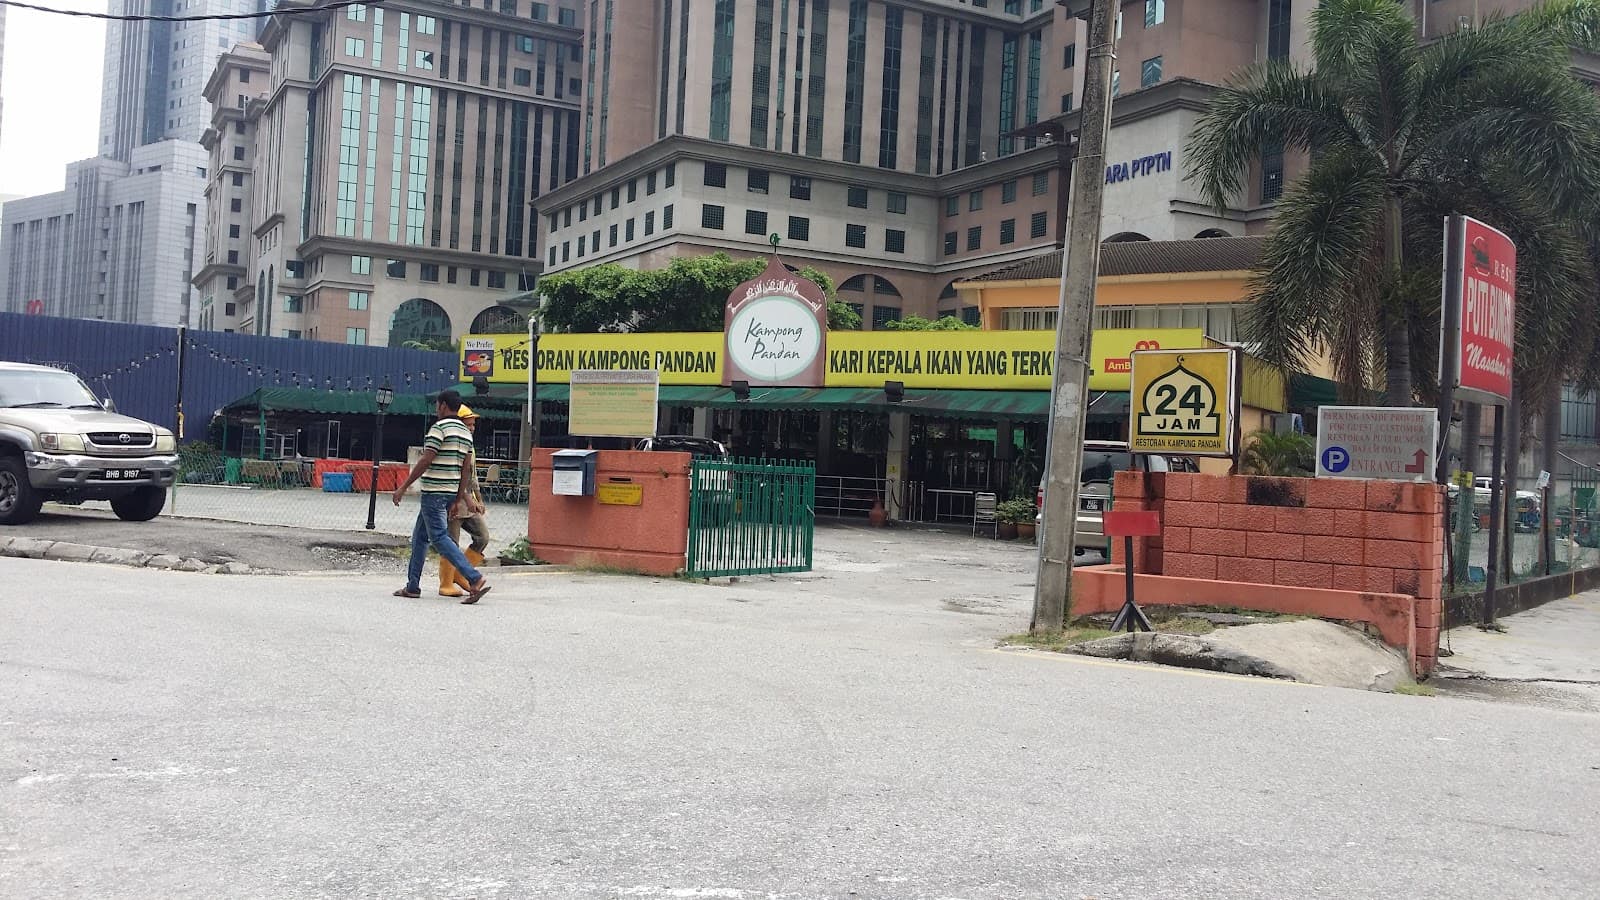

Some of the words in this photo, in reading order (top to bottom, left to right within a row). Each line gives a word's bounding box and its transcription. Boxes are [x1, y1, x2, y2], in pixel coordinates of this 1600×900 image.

[1131, 151, 1172, 179] PTPTN
[745, 317, 803, 346] Kampong
[751, 338, 801, 360] Pandan
[504, 350, 574, 371] RESORAN
[578, 350, 650, 371] KAMPONG
[830, 350, 863, 374] KARI
[868, 350, 922, 374] KEPALA
[926, 351, 962, 374] IKAN
[967, 351, 1007, 376] YANG
[1155, 384, 1205, 416] 24
[1157, 418, 1200, 430] JAM
[1136, 438, 1165, 447] RESTORAN
[1168, 439, 1196, 448] KAMPUNG
[1197, 440, 1221, 449] PANDAN
[124, 469, 140, 478] 9197
[1351, 460, 1402, 473] ENTRANCE
